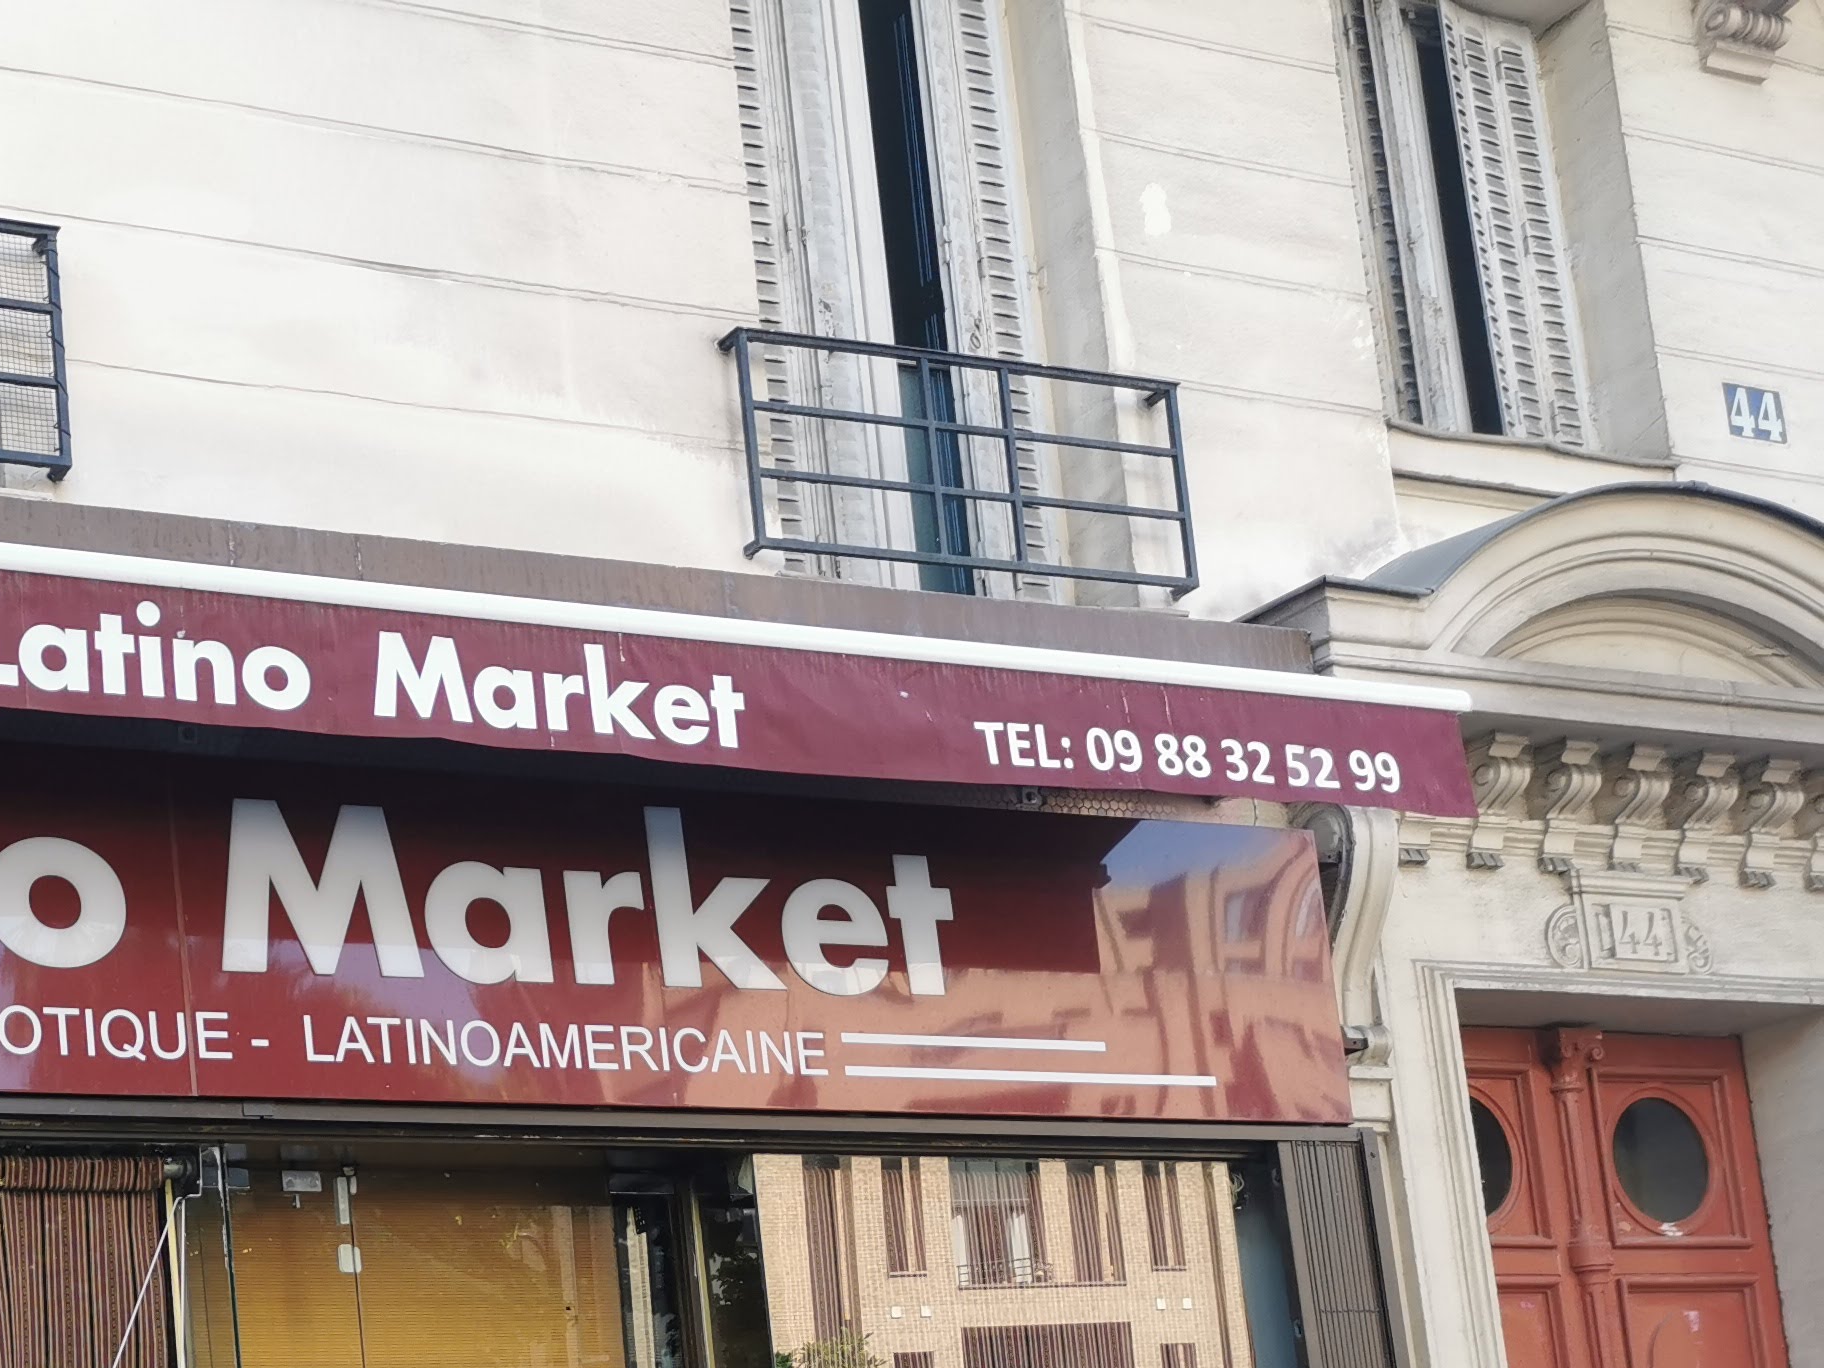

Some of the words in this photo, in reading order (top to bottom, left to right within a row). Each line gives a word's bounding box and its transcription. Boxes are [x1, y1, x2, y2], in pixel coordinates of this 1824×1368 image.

[1730, 387, 1783, 442] 44
[374, 630, 744, 750] Market
[973, 721, 1075, 770] TEL:
[1084, 726, 1143, 774] 09
[1154, 732, 1212, 779] 88
[1220, 738, 1276, 785] 32
[1285, 743, 1341, 790] 52
[1347, 748, 1401, 794] 99
[220, 800, 954, 997] Market
[1618, 910, 1657, 958] 44
[303, 1014, 831, 1077] LATINOAMERICAINE
